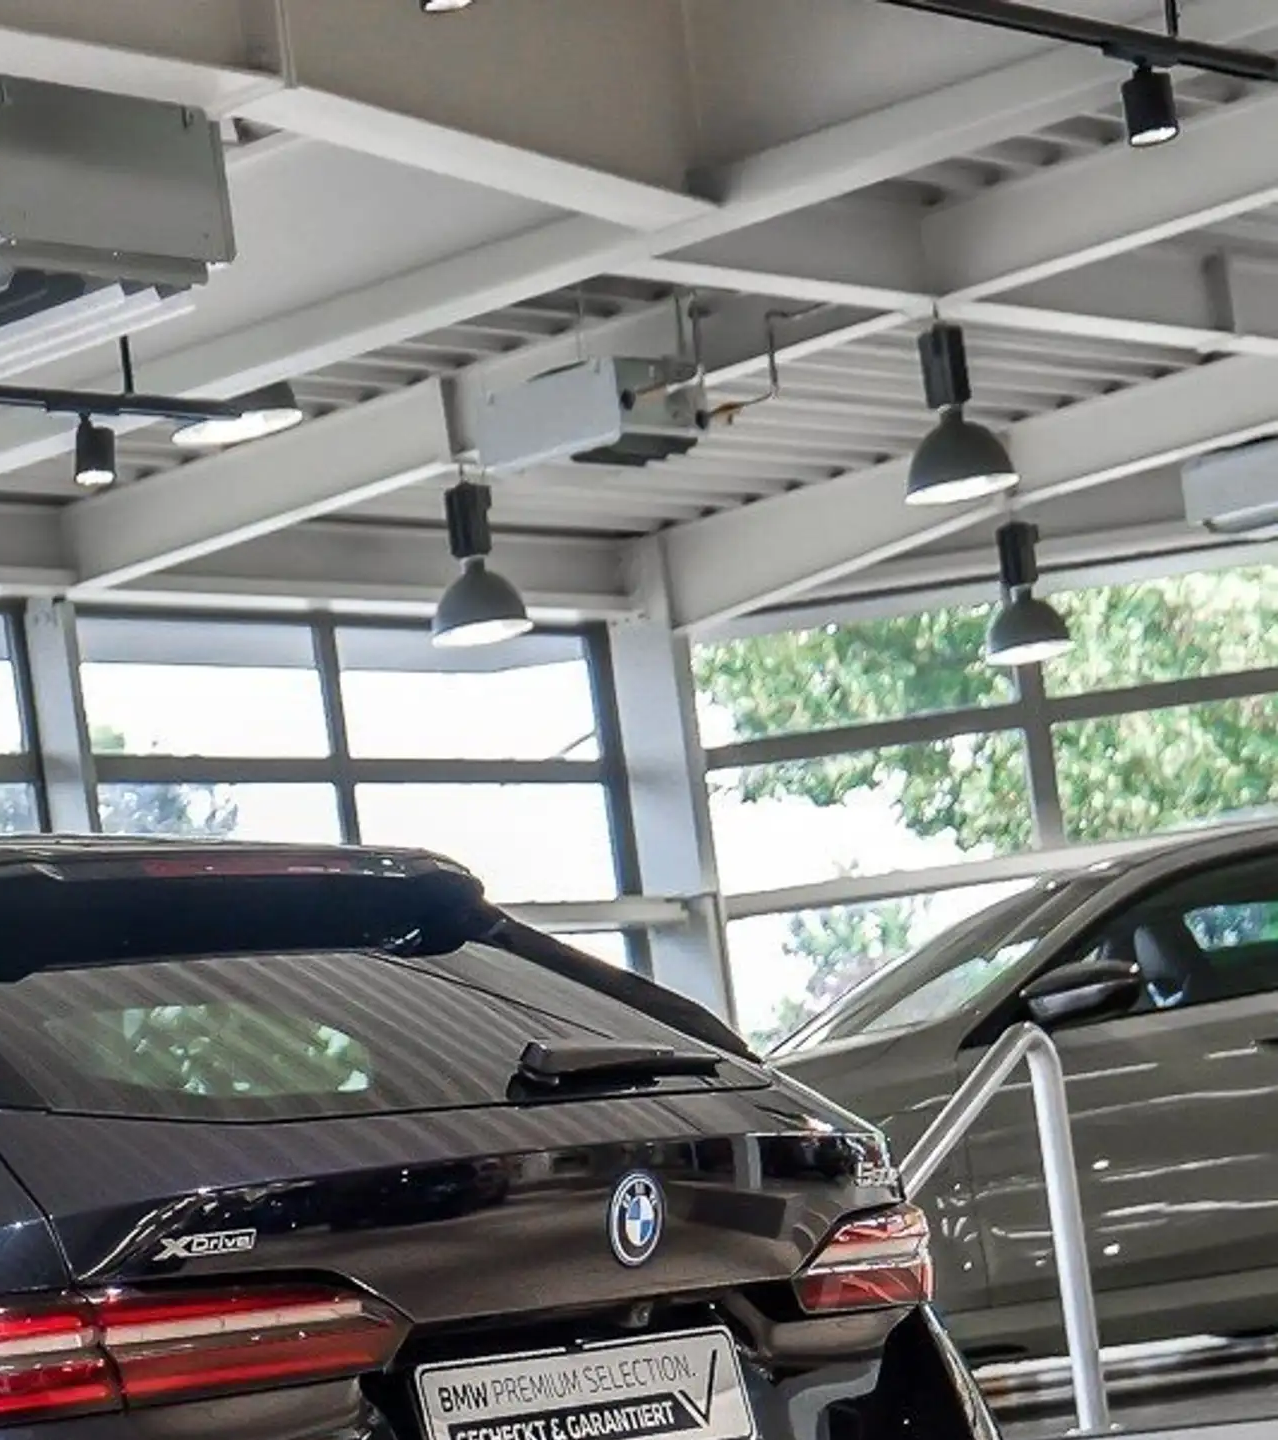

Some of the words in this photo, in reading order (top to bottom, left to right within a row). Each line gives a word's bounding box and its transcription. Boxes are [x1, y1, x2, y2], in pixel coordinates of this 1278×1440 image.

[438, 1381, 488, 1412] BMW
[491, 1369, 583, 1405] PREMIUM
[582, 1354, 696, 1393] SELECTION.
[566, 1401, 676, 1440] GARANTIERT
